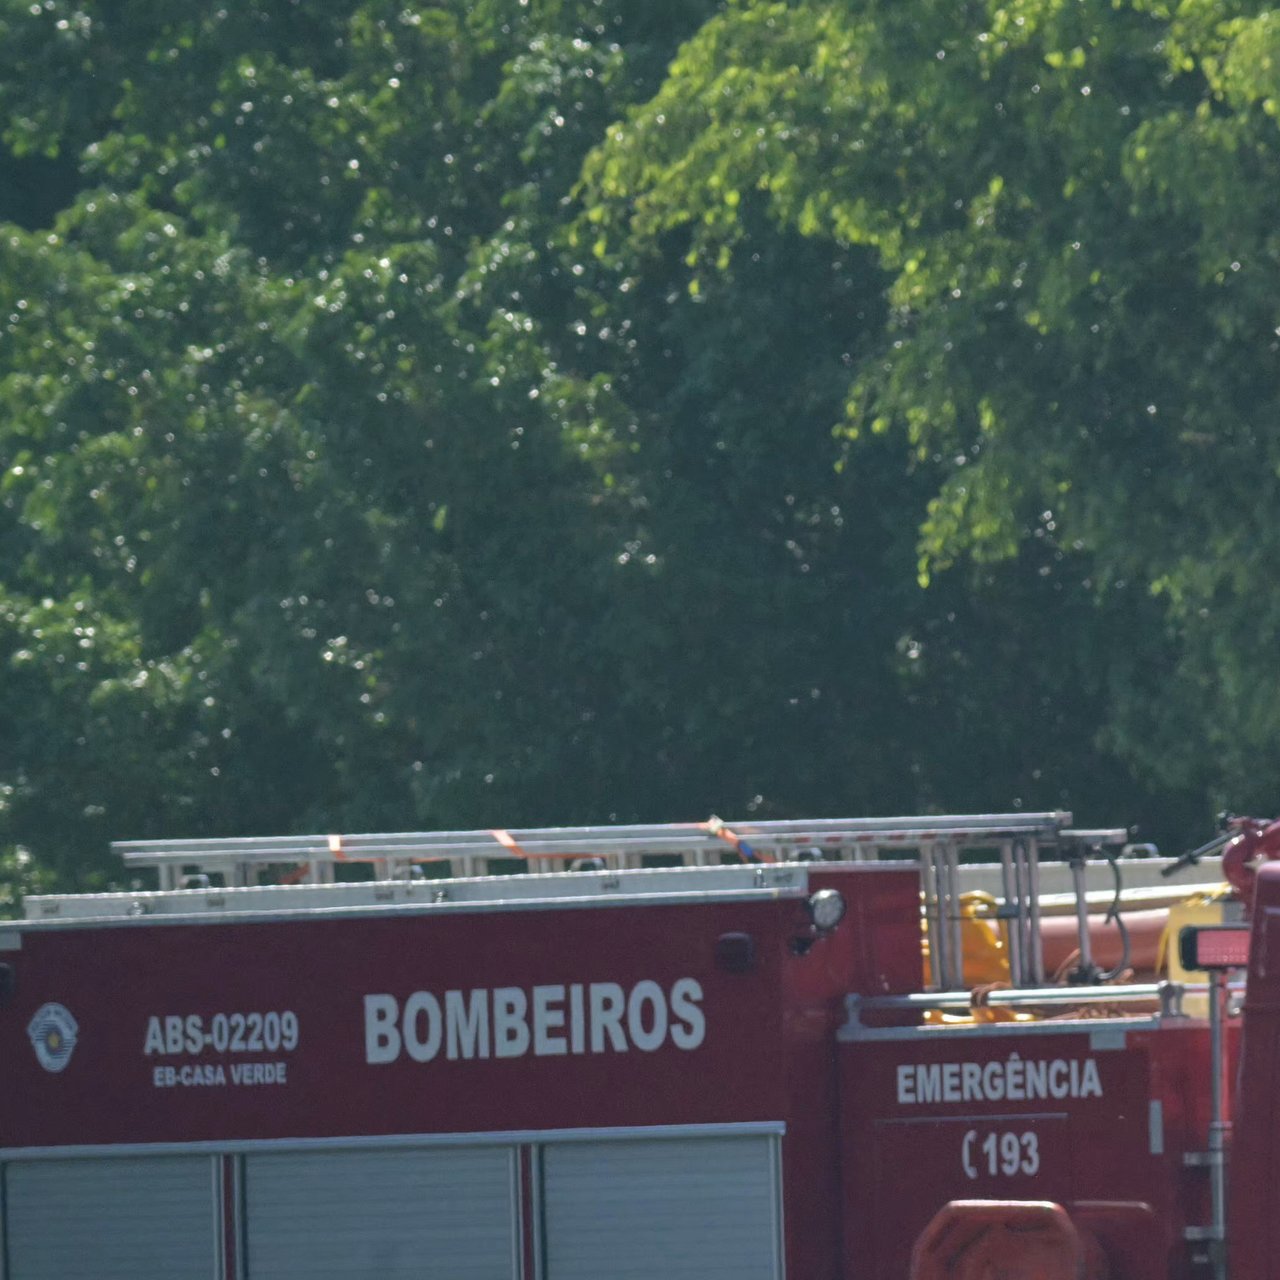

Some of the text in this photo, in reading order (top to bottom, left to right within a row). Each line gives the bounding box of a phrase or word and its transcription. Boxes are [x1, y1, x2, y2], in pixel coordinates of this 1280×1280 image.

[144, 1010, 299, 1057] ABS-02209
[364, 977, 706, 1065] BOMBEIROS
[153, 1062, 287, 1088] EB-CASA VERDE
[897, 1052, 1102, 1104] EMERGÊNCIA
[982, 1131, 1040, 1176] 193
